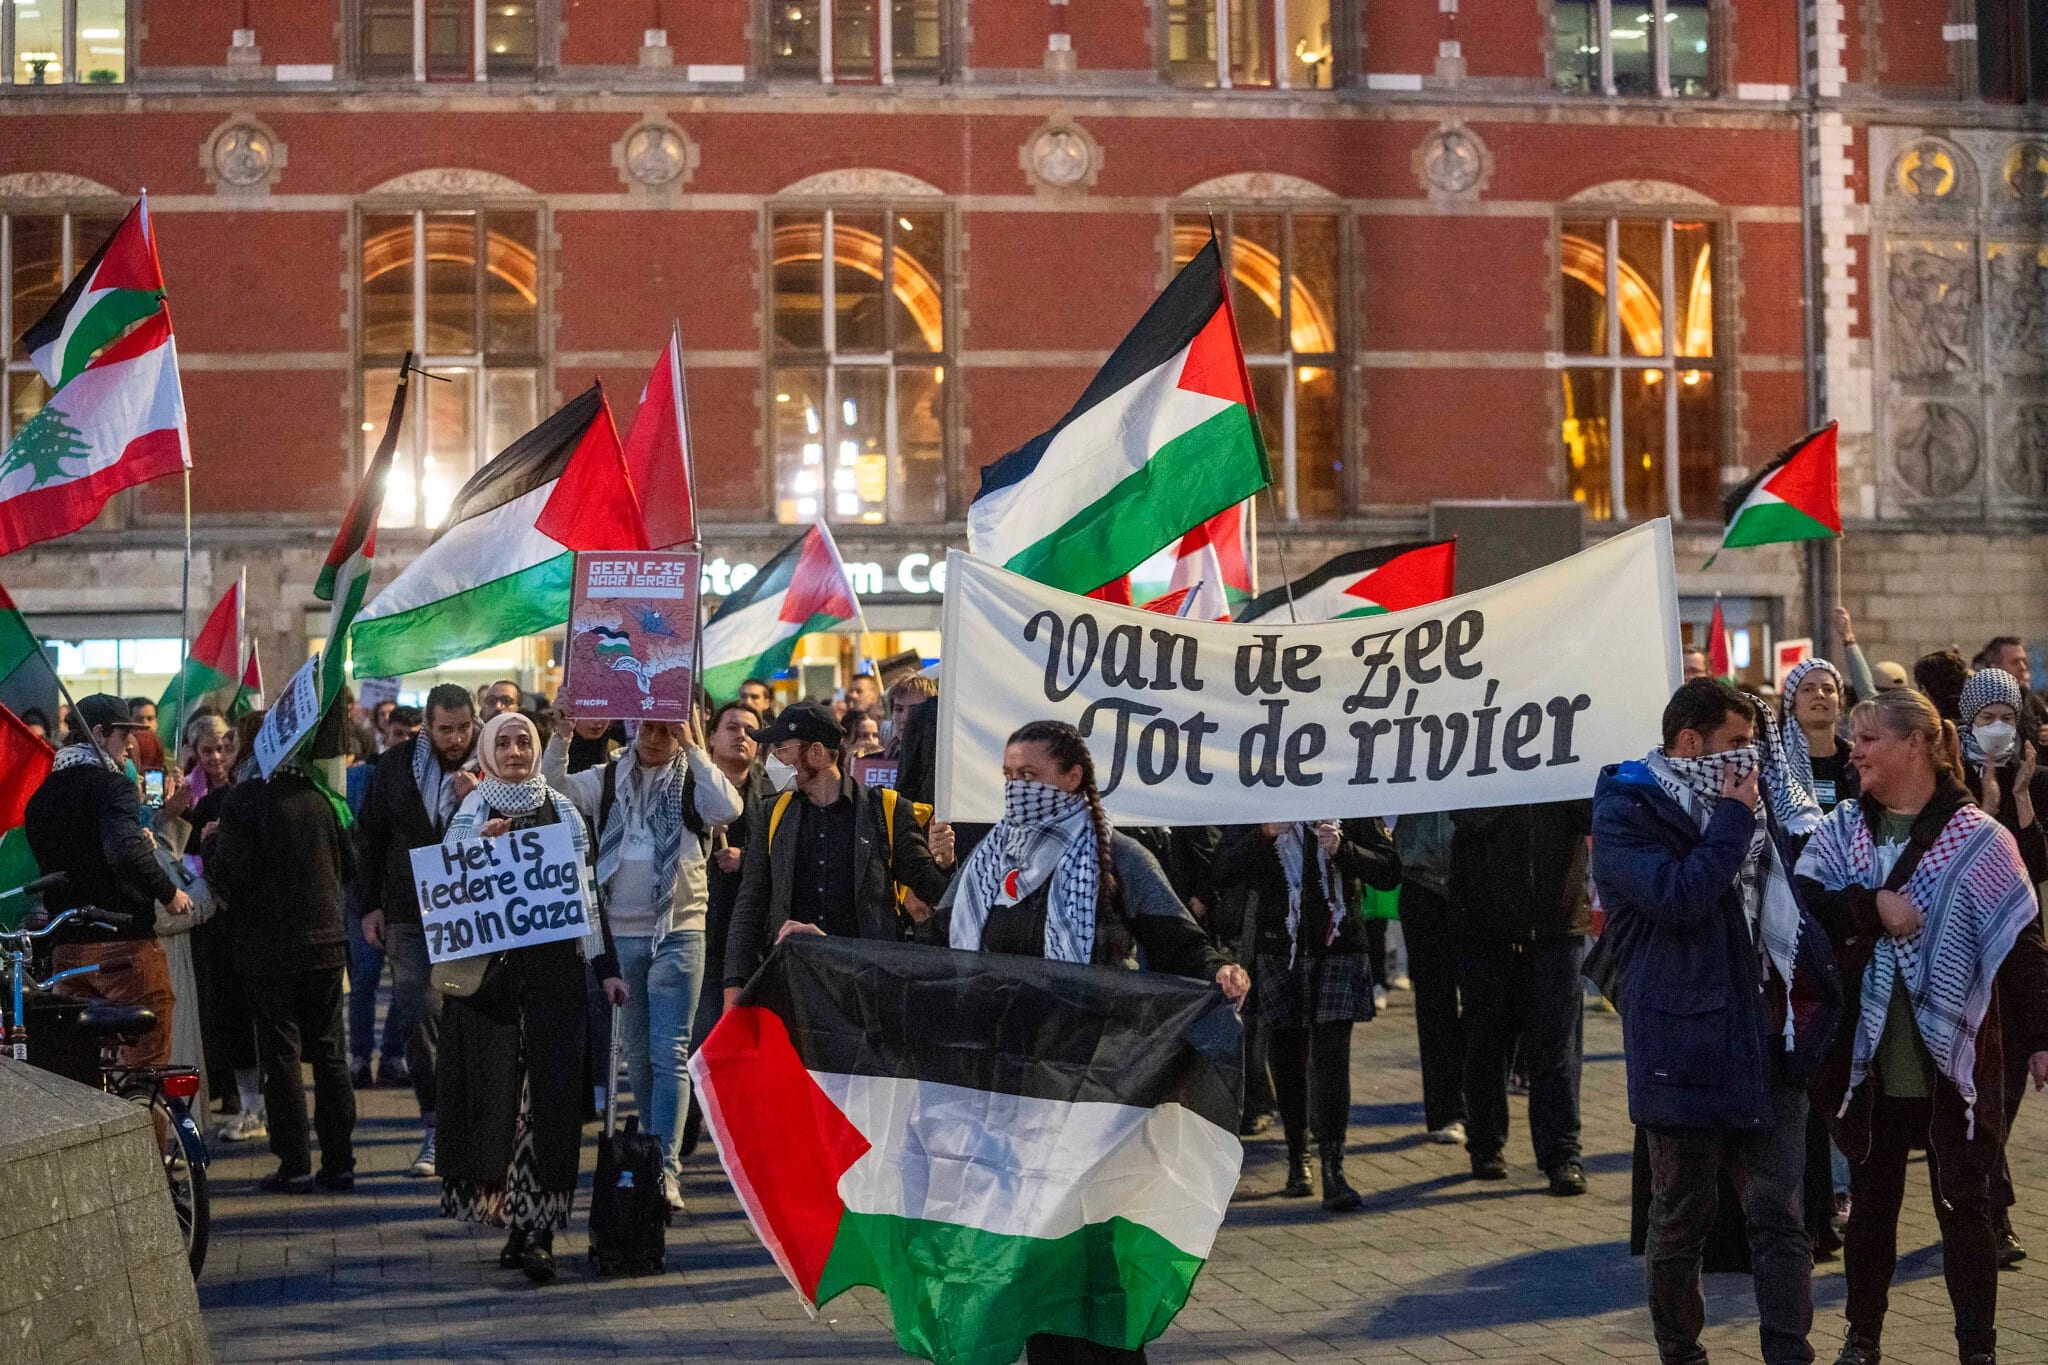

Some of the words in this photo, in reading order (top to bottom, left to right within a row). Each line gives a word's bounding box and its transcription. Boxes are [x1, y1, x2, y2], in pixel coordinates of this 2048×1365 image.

[588, 575, 628, 587] NAAR
[632, 575, 685, 588] ISRAEL
[589, 561, 638, 575] GEEN
[643, 561, 686, 576] F-35
[1023, 610, 1205, 703] Van
[1234, 634, 1323, 696] de
[1342, 609, 1485, 715] Zee
[1078, 697, 1220, 799] Tot
[1238, 699, 1327, 788] de
[1347, 678, 1592, 786] rivier
[421, 870, 517, 912] iedere
[523, 857, 580, 896] dag
[441, 839, 501, 875] Het
[425, 917, 474, 955] 7-10
[474, 910, 506, 945] in
[504, 896, 585, 936] Gaza
